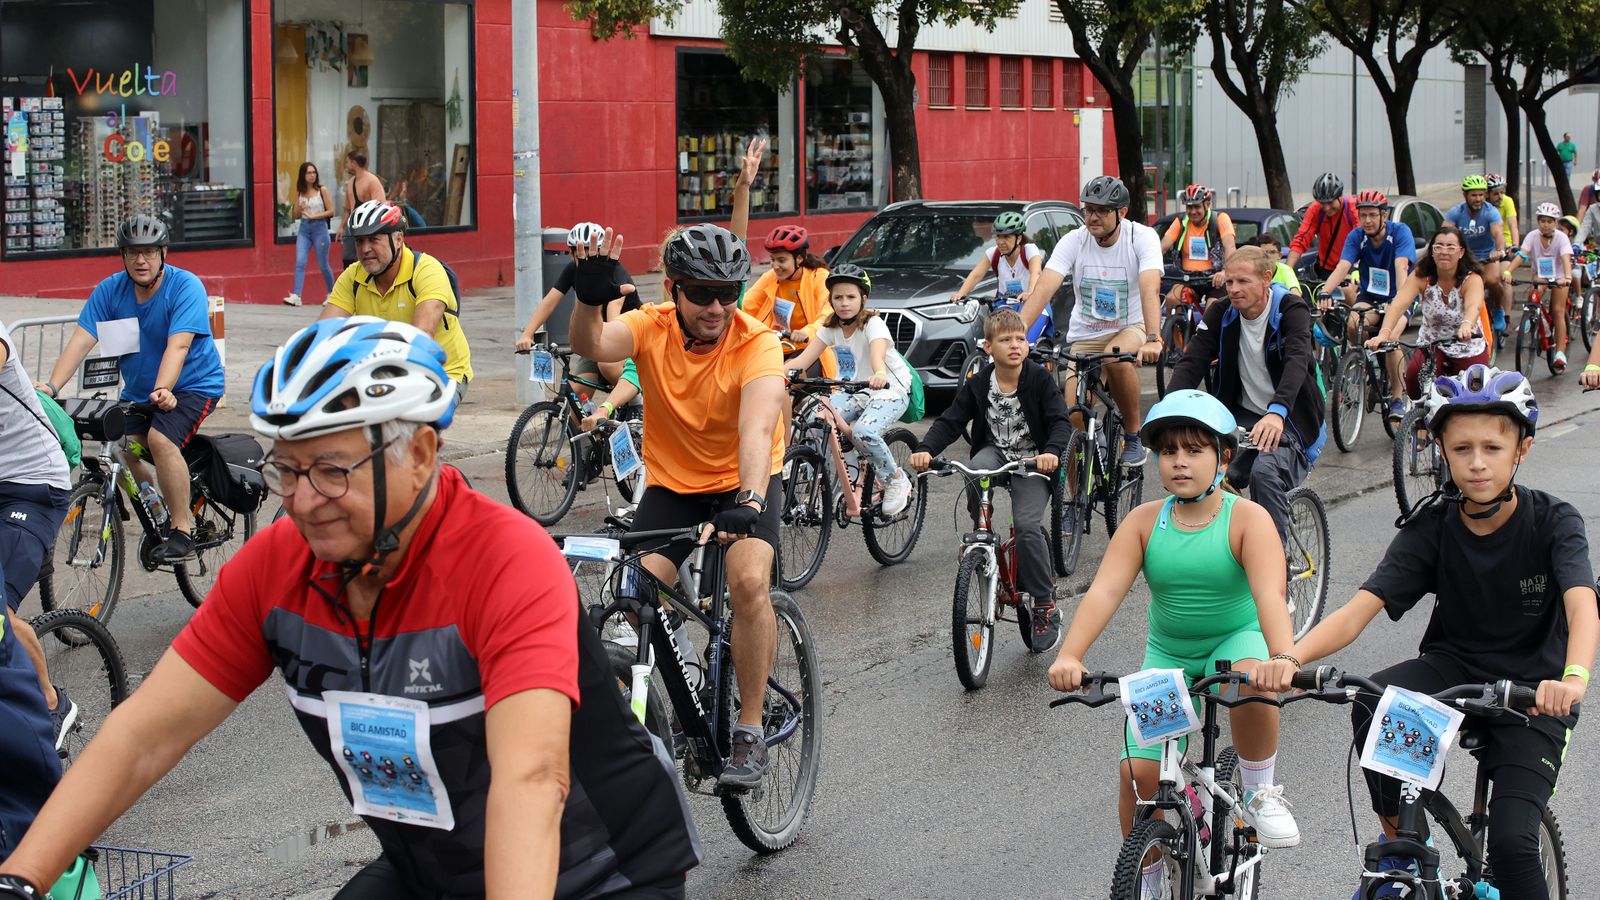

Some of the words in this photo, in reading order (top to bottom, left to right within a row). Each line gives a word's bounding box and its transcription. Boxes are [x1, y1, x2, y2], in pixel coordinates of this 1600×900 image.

[67, 63, 177, 97] Vuelta
[106, 104, 126, 128] al
[104, 133, 170, 163] Cole
[10, 511, 27, 520] HH
[1521, 583, 1546, 595] SURF
[657, 606, 706, 717] ROCKRIDER
[351, 722, 366, 732] BICI
[368, 725, 407, 738] AMISTAD
